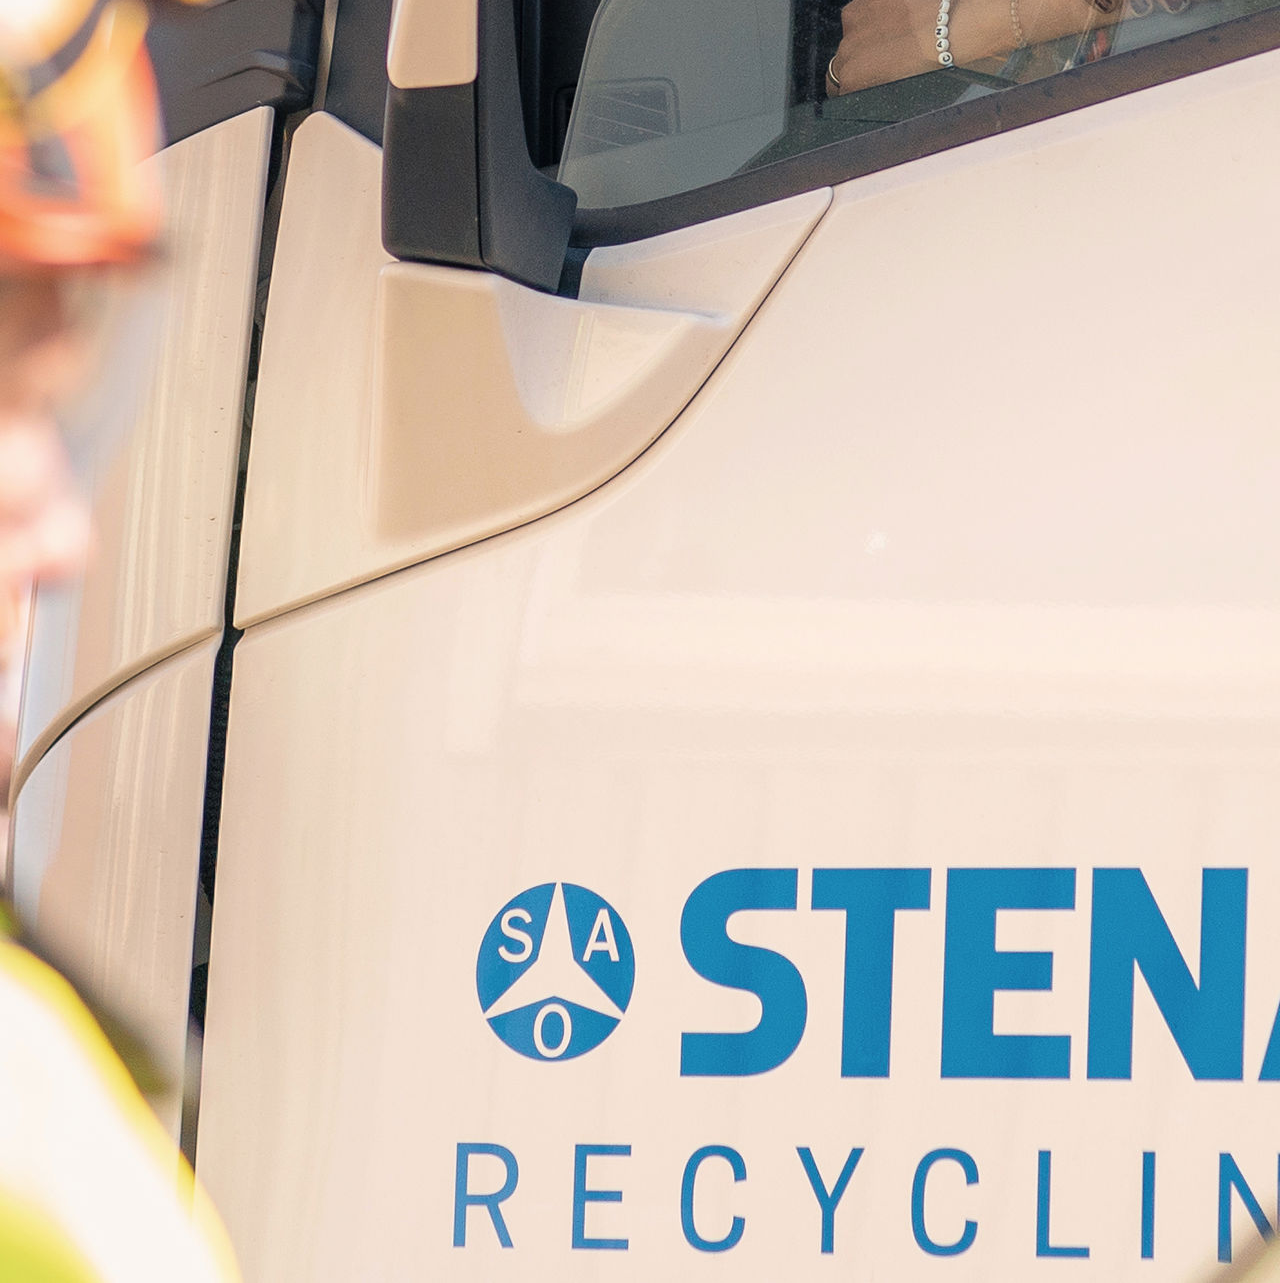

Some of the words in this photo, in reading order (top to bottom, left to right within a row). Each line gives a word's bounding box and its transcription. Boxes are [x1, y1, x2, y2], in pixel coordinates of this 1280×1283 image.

[497, 907, 534, 964] S
[582, 907, 620, 963] A
[533, 1002, 572, 1059] O
